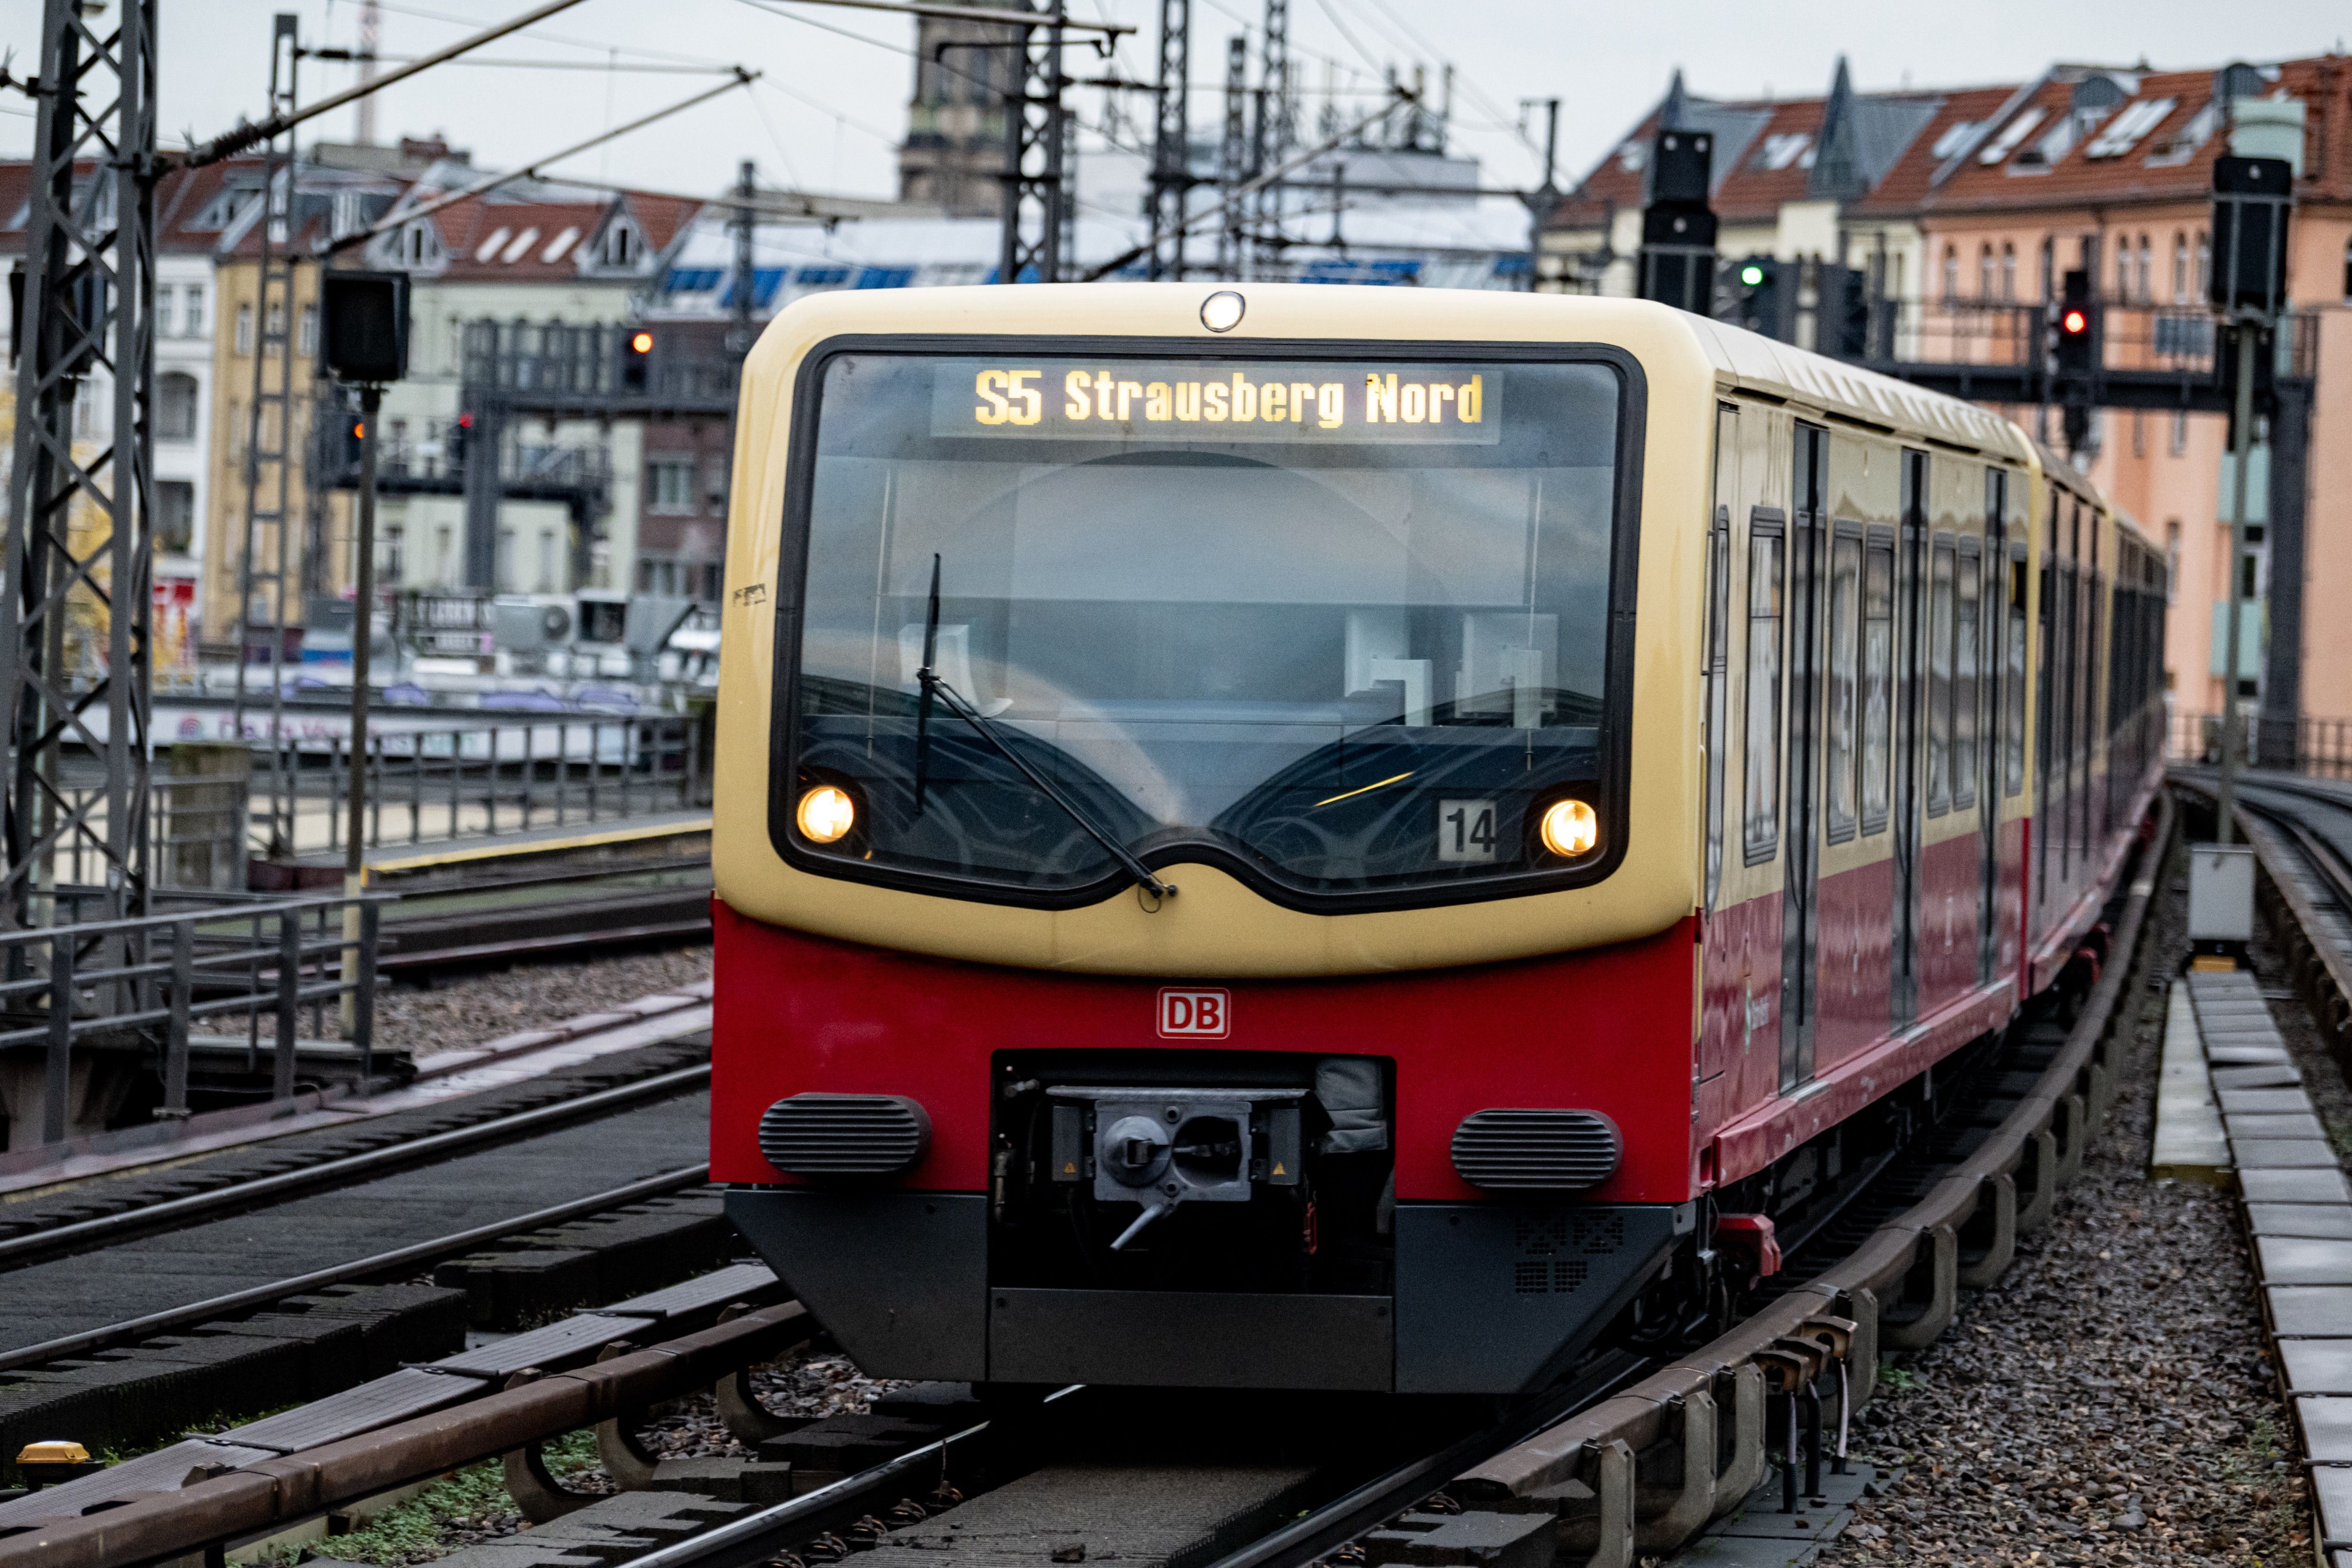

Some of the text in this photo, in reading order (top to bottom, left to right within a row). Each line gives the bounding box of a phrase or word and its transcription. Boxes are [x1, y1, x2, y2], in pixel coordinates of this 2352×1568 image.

[975, 370, 1482, 428] S5 Strausberg Nord
[1446, 808, 1497, 853] 14
[1168, 996, 1220, 1029] DB
